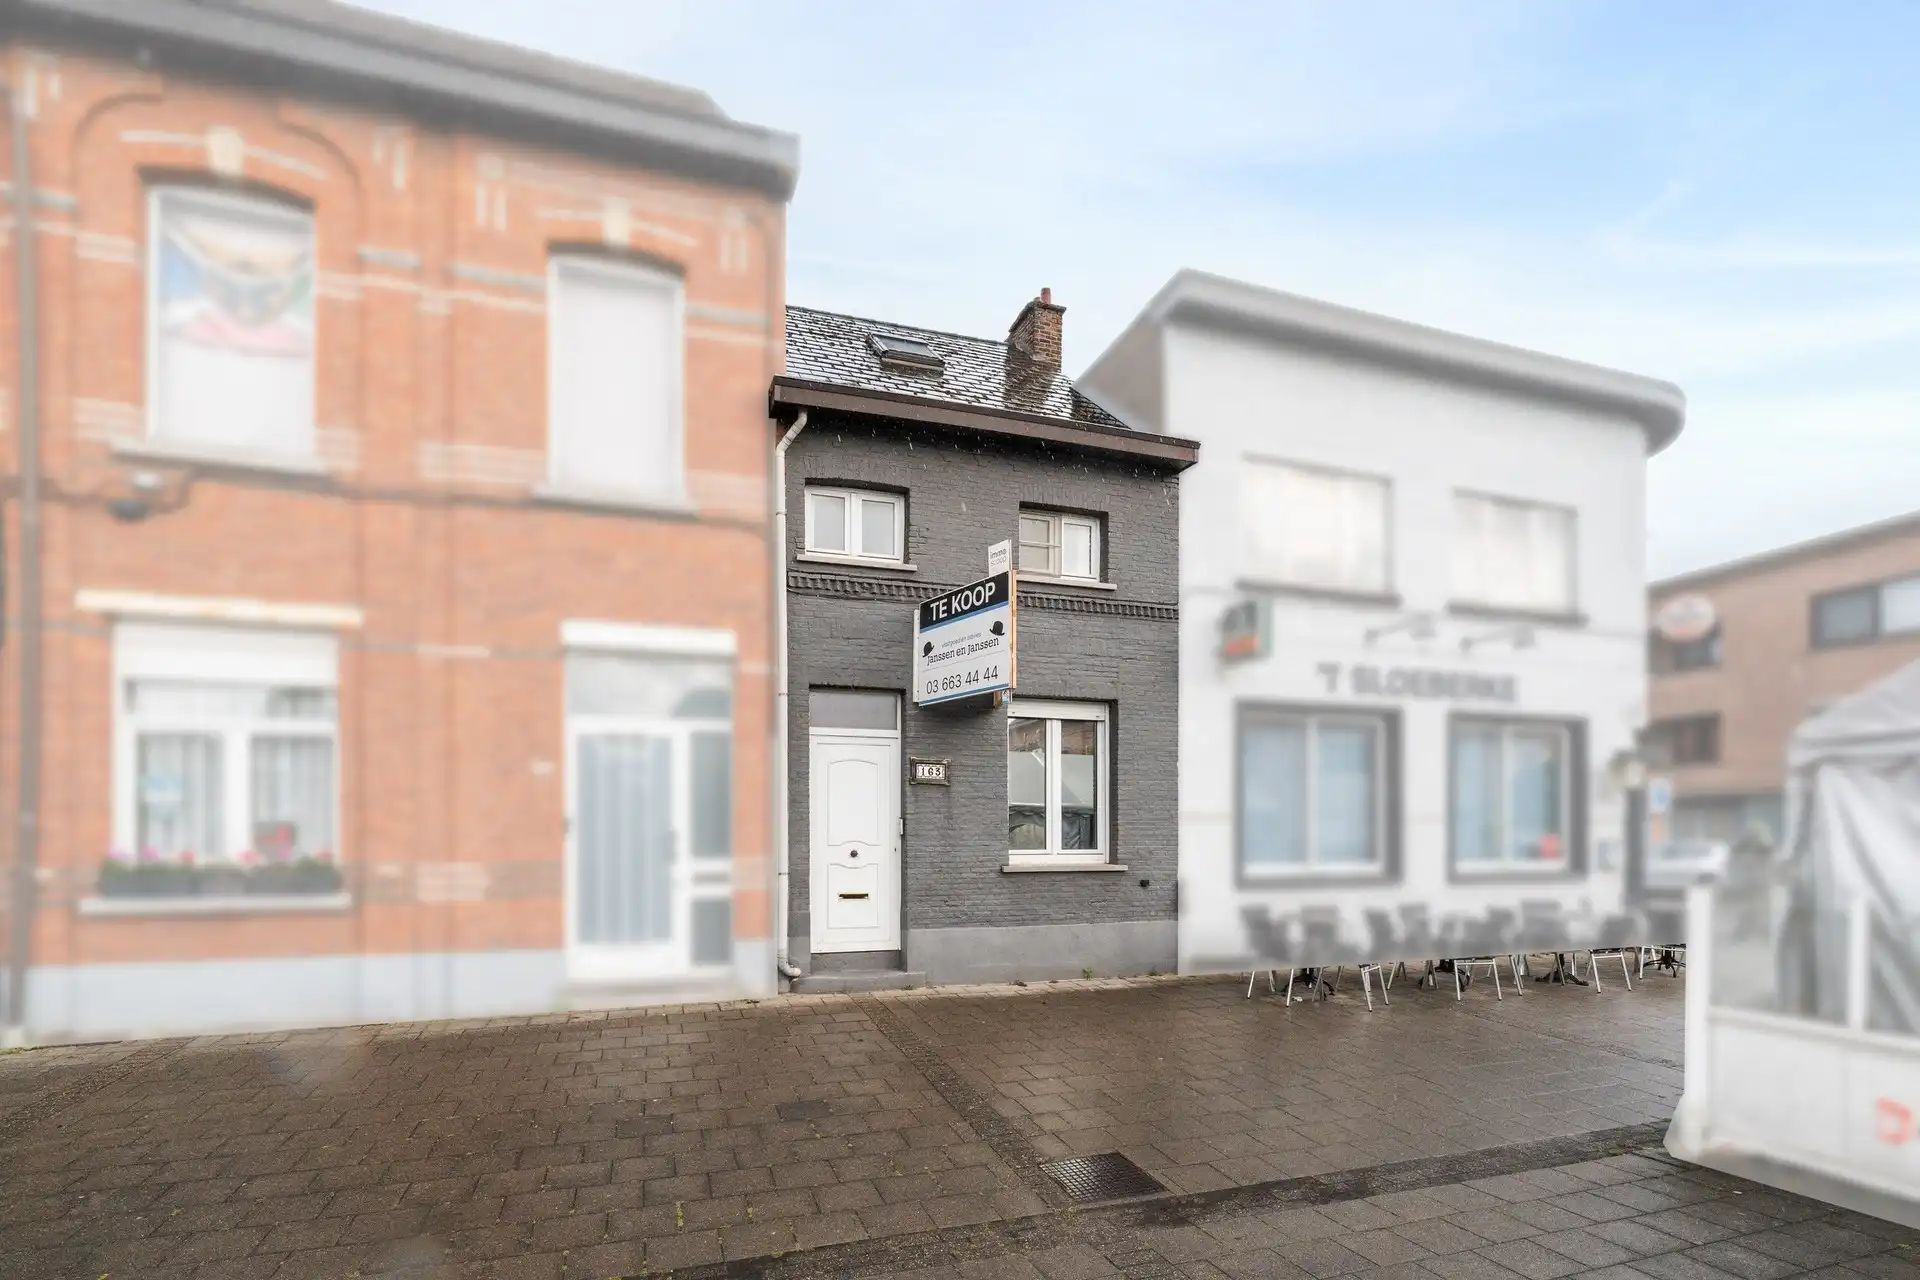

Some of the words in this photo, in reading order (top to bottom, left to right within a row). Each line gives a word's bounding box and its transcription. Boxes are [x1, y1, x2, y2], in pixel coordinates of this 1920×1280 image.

[930, 598, 948, 621] TE
[952, 581, 996, 615] KOOP
[956, 647, 966, 657] en
[926, 679, 939, 695] 03
[942, 673, 962, 691] 663
[965, 669, 979, 686] 44
[983, 665, 999, 681] 44
[921, 767, 941, 777] 163
